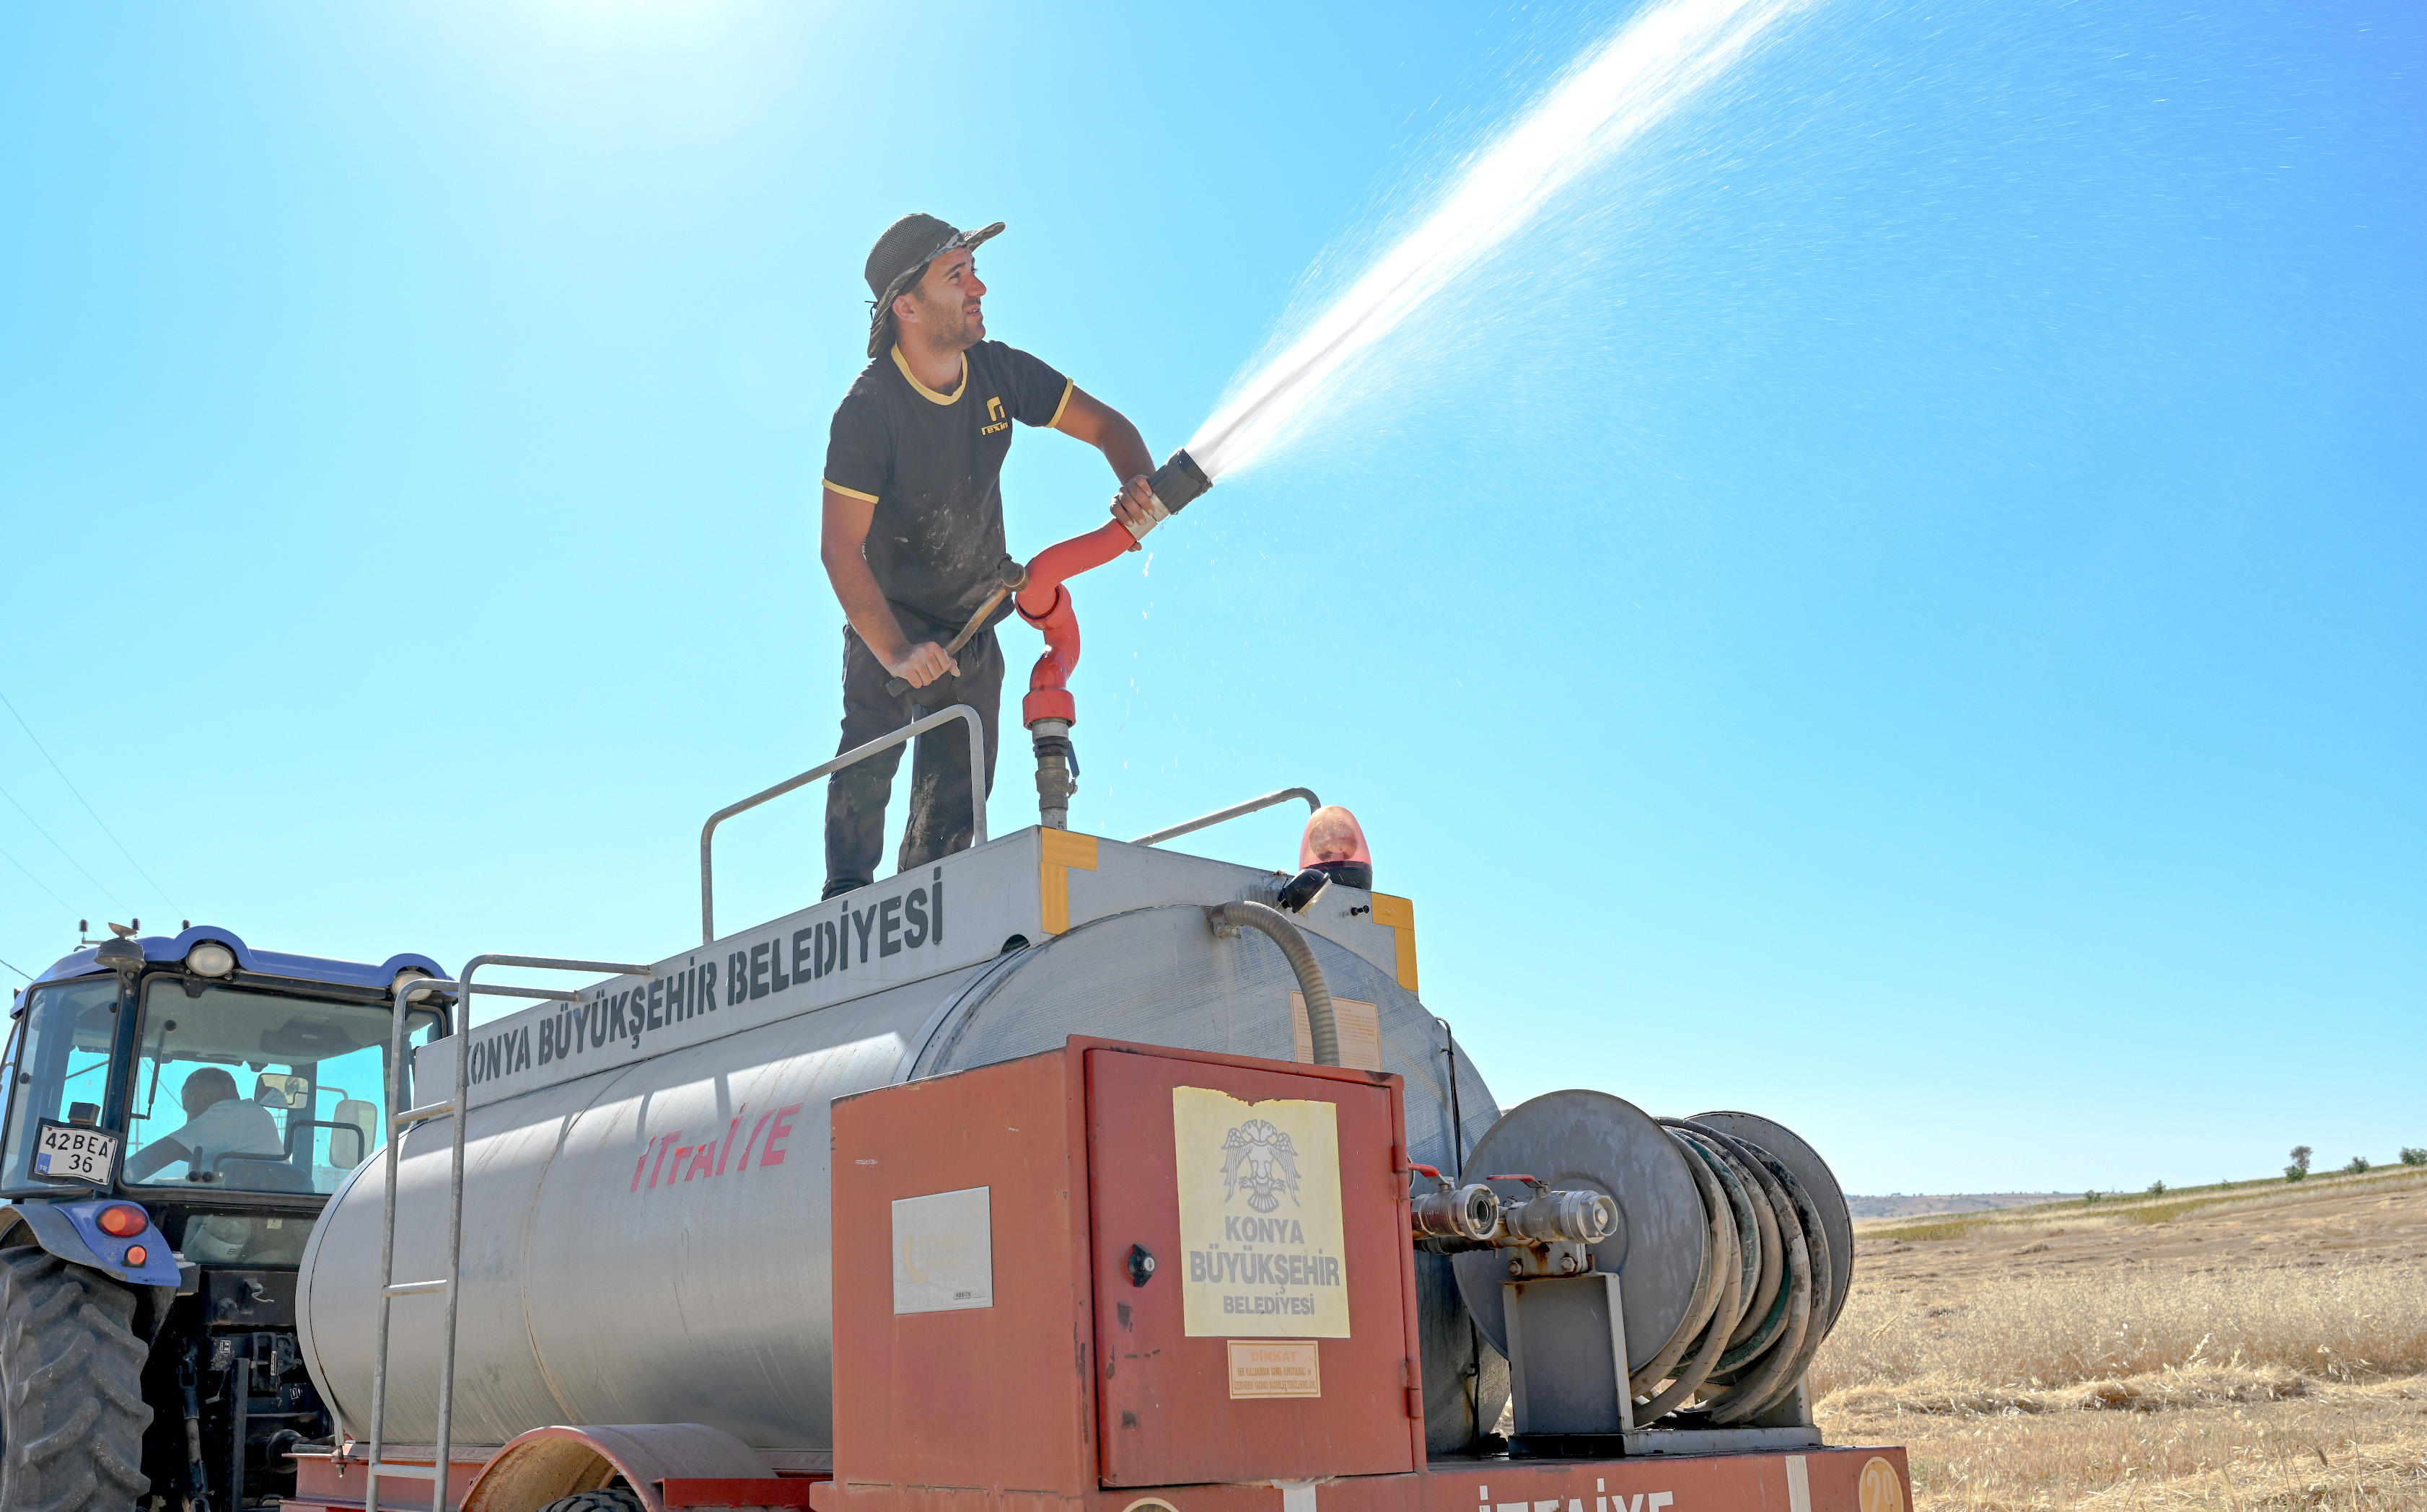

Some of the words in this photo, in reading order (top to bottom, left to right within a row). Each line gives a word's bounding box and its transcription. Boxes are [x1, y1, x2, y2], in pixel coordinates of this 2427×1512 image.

[538, 956, 716, 1067] BÜYÜKŞEHİR
[728, 866, 942, 1006] BELEDİYESİ
[69, 1154, 93, 1173] 36
[1225, 1216, 1304, 1244] KONYA
[1190, 1243, 1340, 1294] BÜYÜKŞEHİR
[1223, 1292, 1315, 1316] BELEDİYESİ
[1251, 1349, 1297, 1362] DİKKAT
